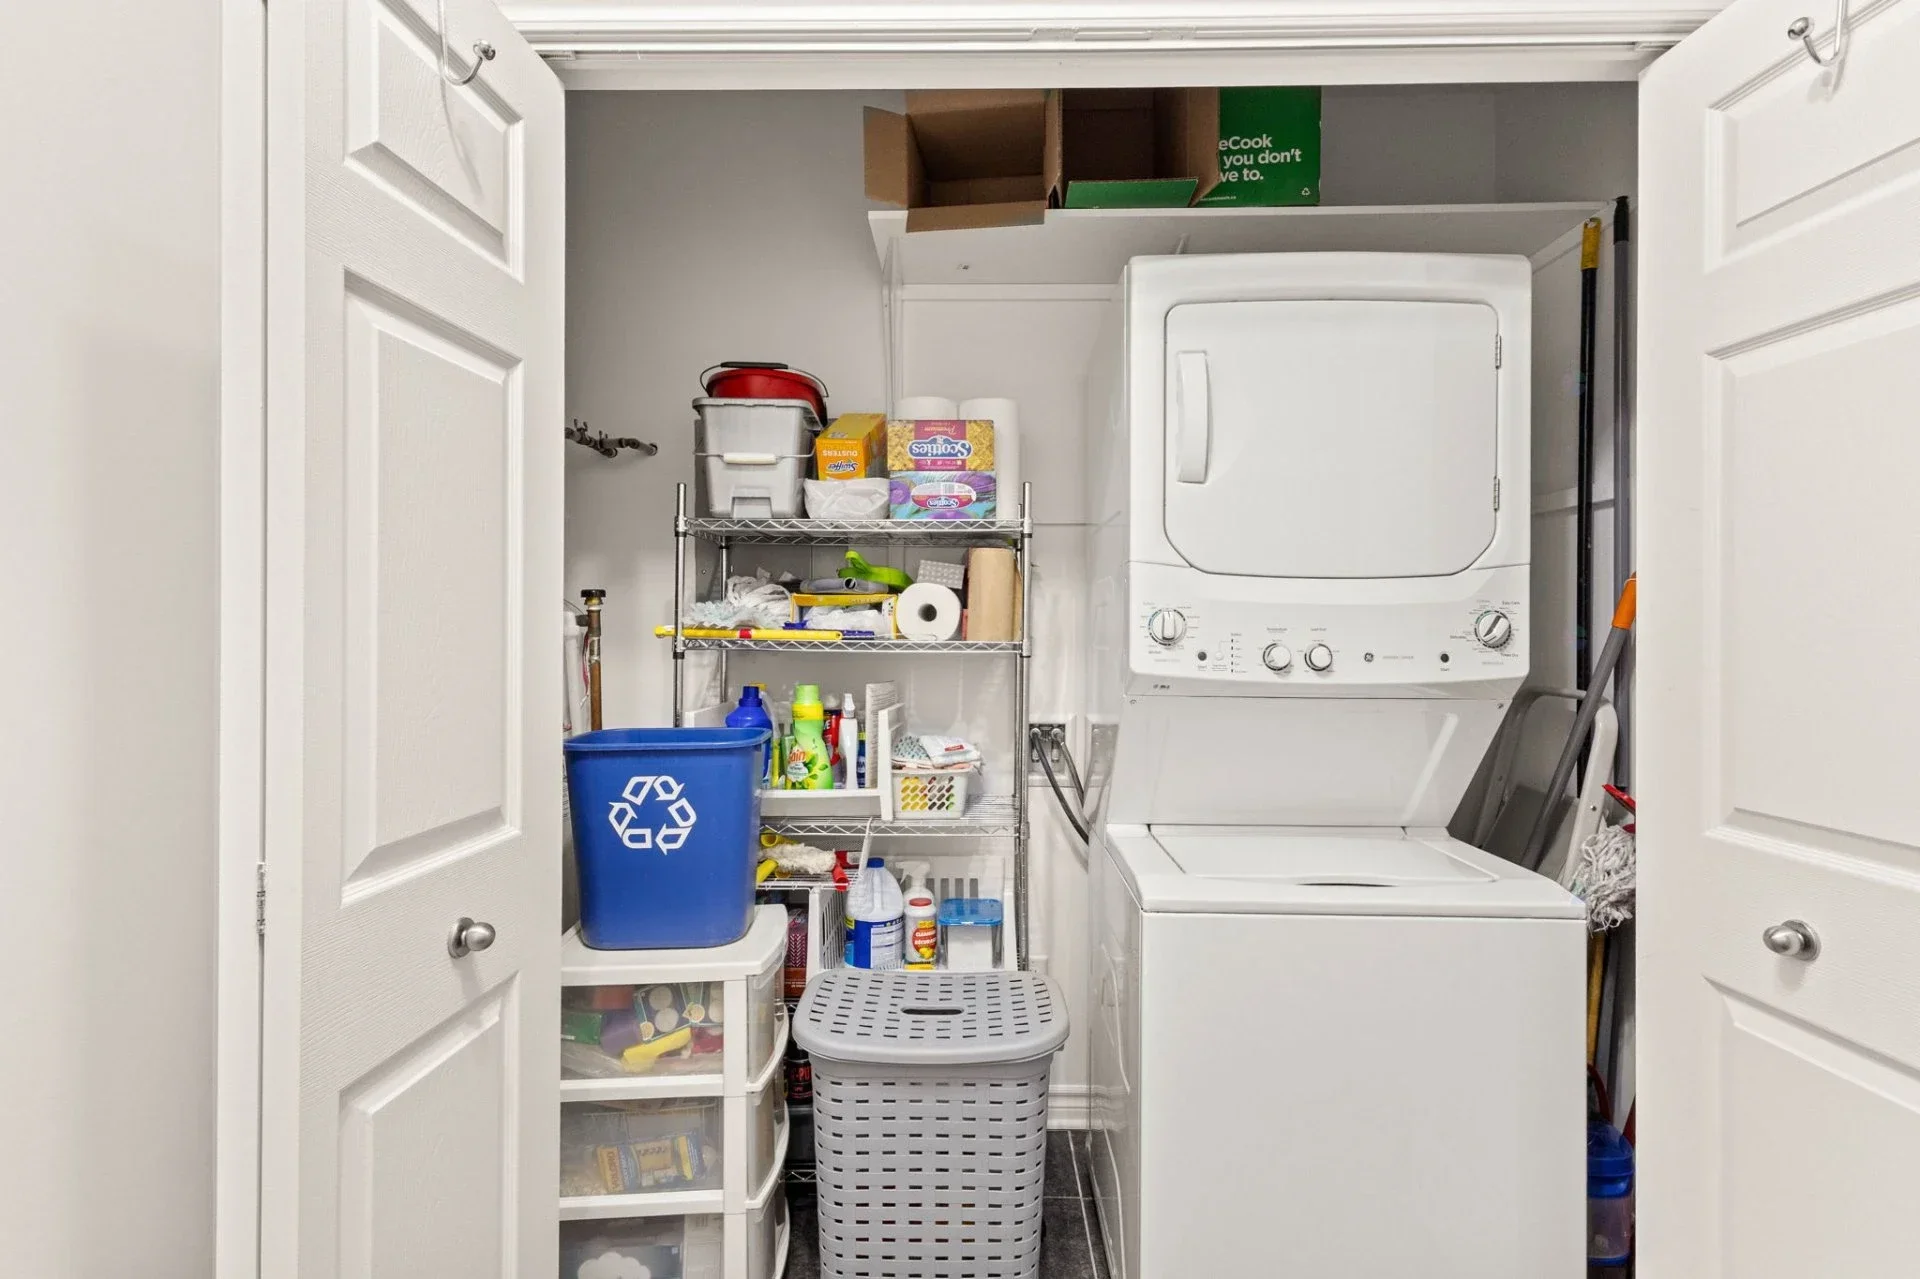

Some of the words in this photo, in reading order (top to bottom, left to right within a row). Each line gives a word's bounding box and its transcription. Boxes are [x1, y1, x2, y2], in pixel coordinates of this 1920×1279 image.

[1218, 134, 1272, 150] eCook
[1223, 154, 1254, 169] you
[1258, 148, 1302, 164] don't
[1220, 170, 1239, 182] ve
[1242, 168, 1264, 181] to.
[910, 441, 970, 458] Scotties
[828, 460, 858, 471] Swiffer
[789, 750, 806, 762] ain
